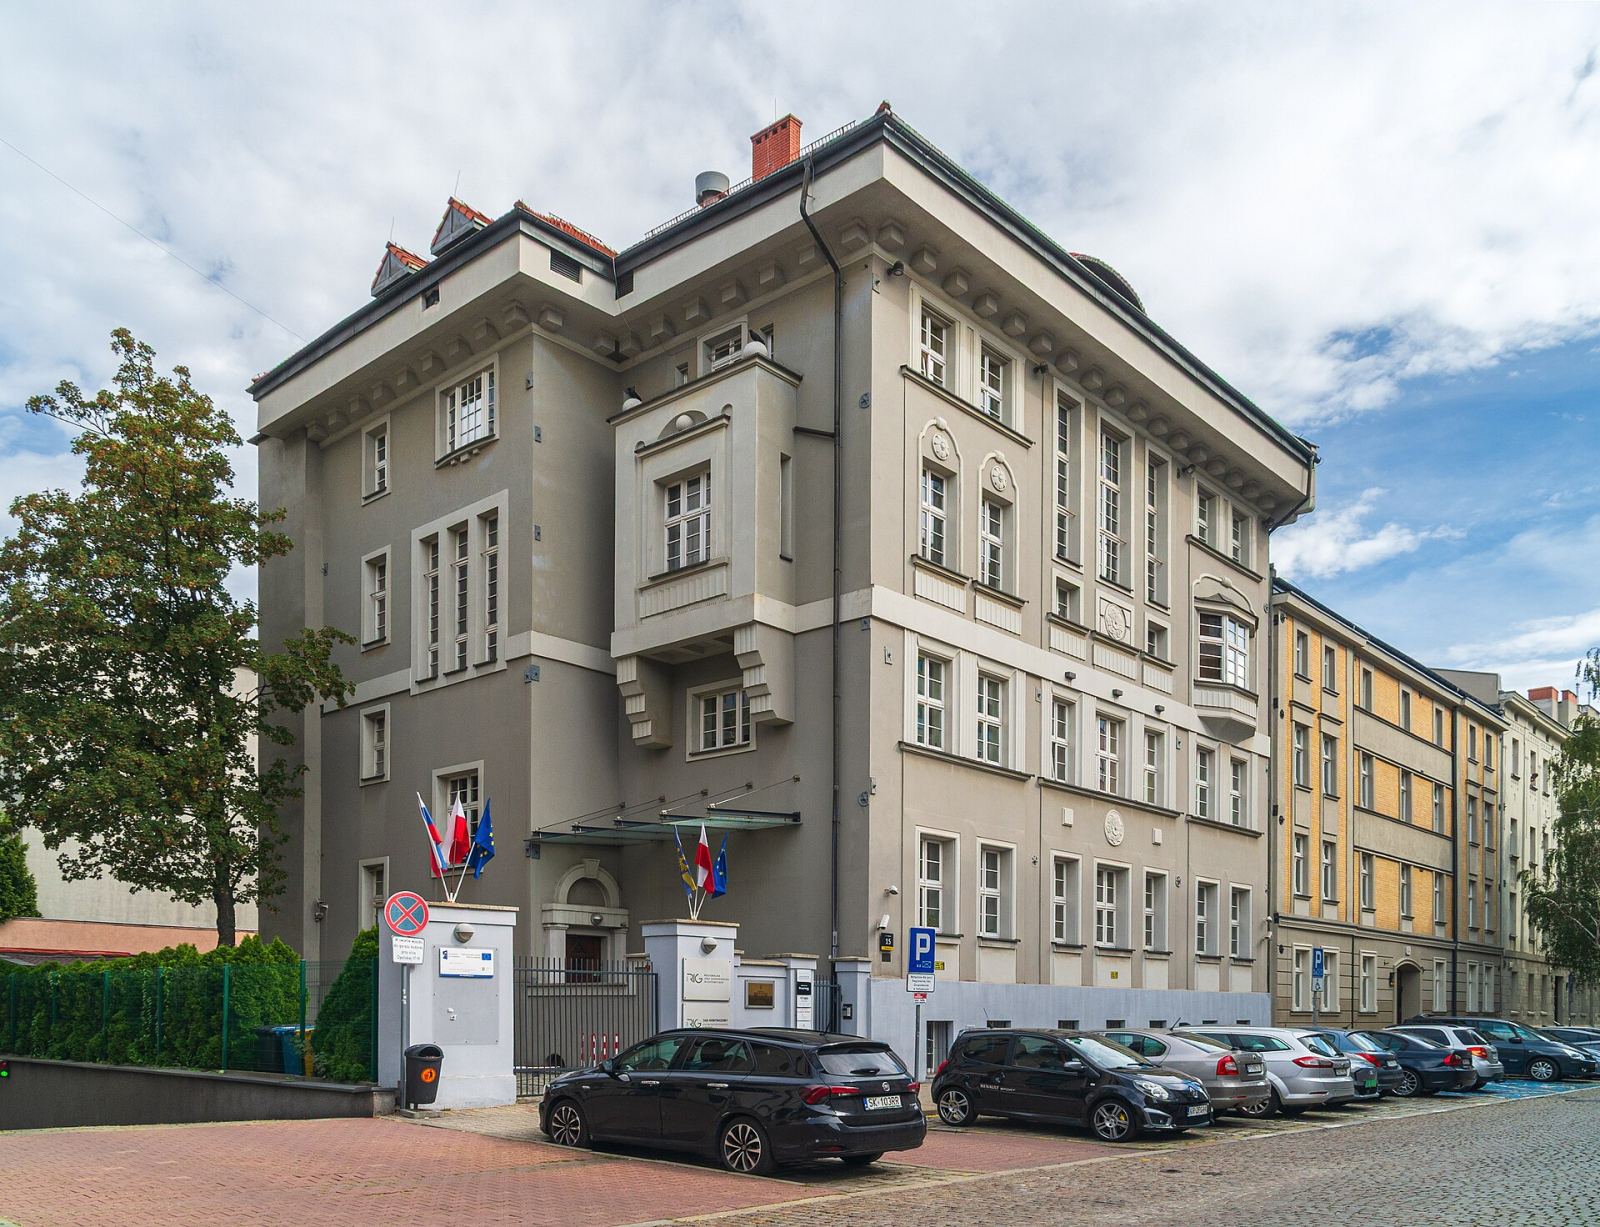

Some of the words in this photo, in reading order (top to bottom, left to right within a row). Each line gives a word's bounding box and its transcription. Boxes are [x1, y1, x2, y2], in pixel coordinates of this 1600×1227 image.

[916, 933, 930, 960] P
[1315, 950, 1322, 969] P
[868, 1097, 877, 1108] SK
[880, 1096, 900, 1107] 103RR
